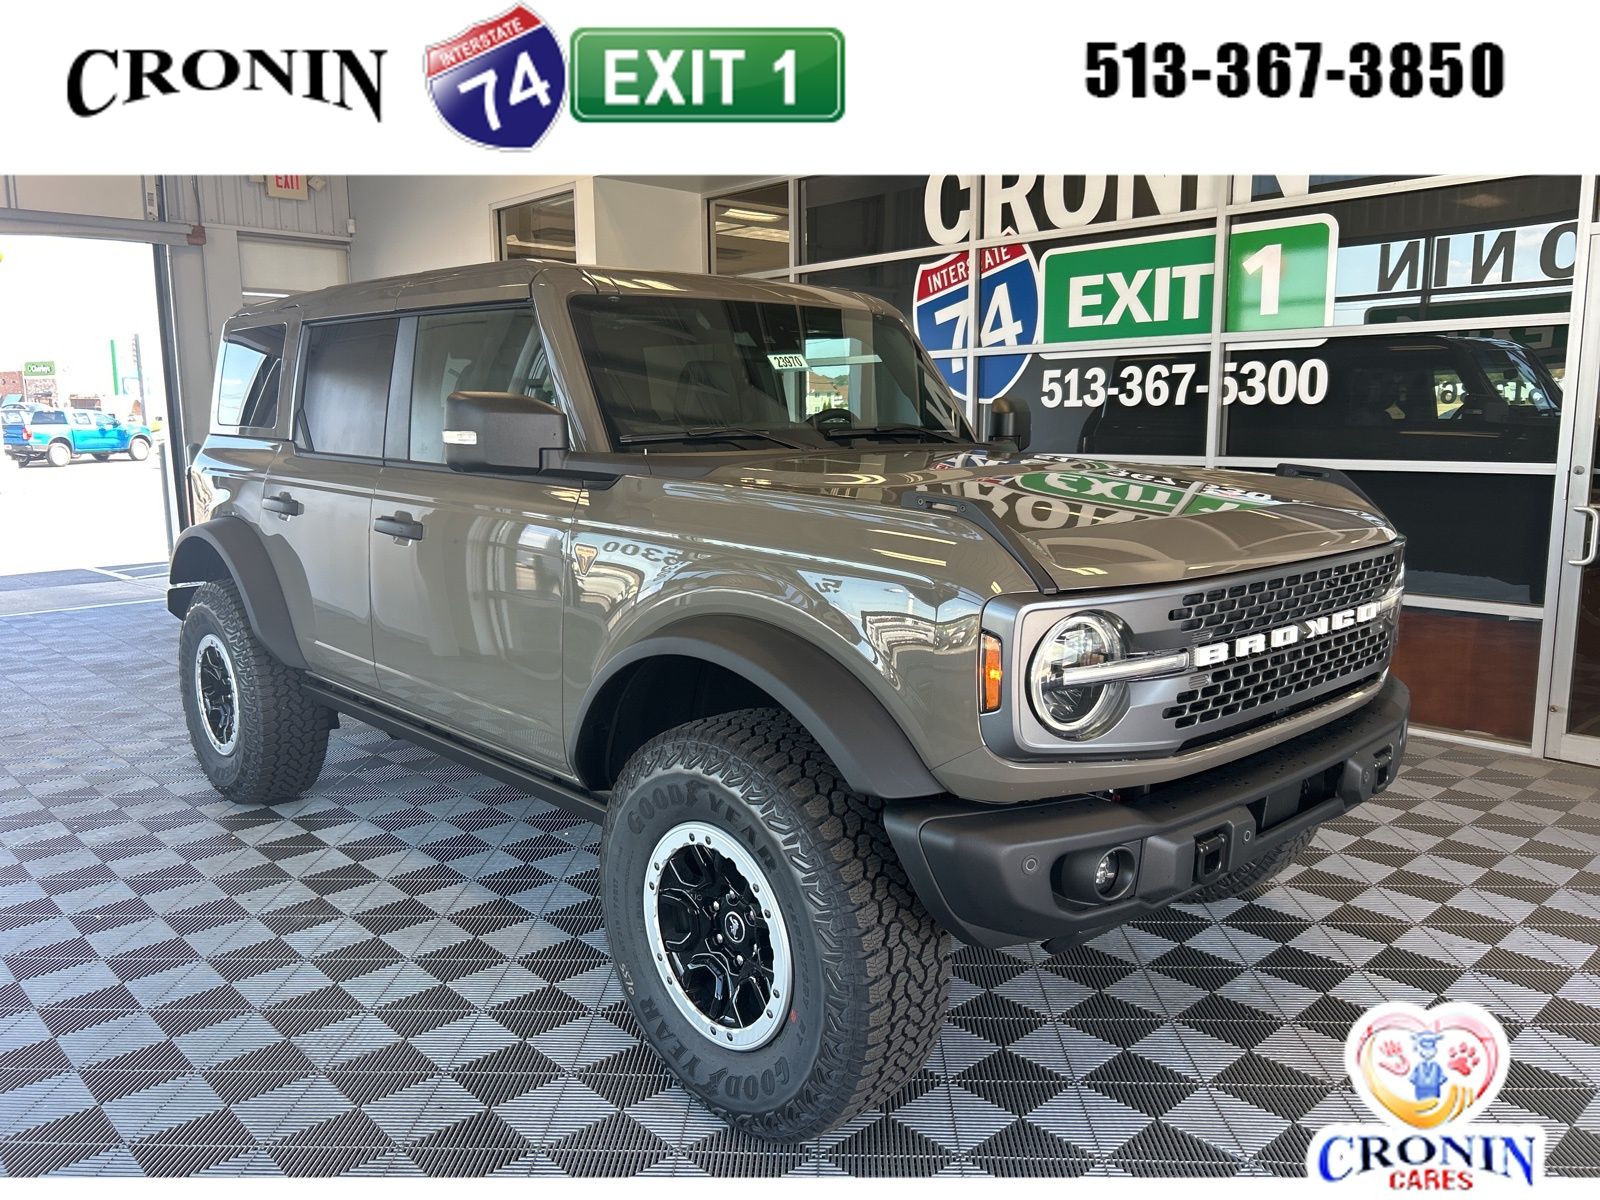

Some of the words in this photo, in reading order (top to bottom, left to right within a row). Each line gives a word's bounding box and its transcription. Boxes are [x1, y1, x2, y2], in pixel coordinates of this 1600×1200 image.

[924, 174, 1310, 245] CRON
[928, 247, 1011, 293] INTERATE
[1068, 263, 1214, 329] EXIT
[1242, 244, 1283, 316] 1
[934, 282, 1024, 373] 74
[773, 355, 803, 368] 23970
[1041, 358, 1329, 409] 513-367-5300
[1194, 602, 1377, 667] BRONCO
